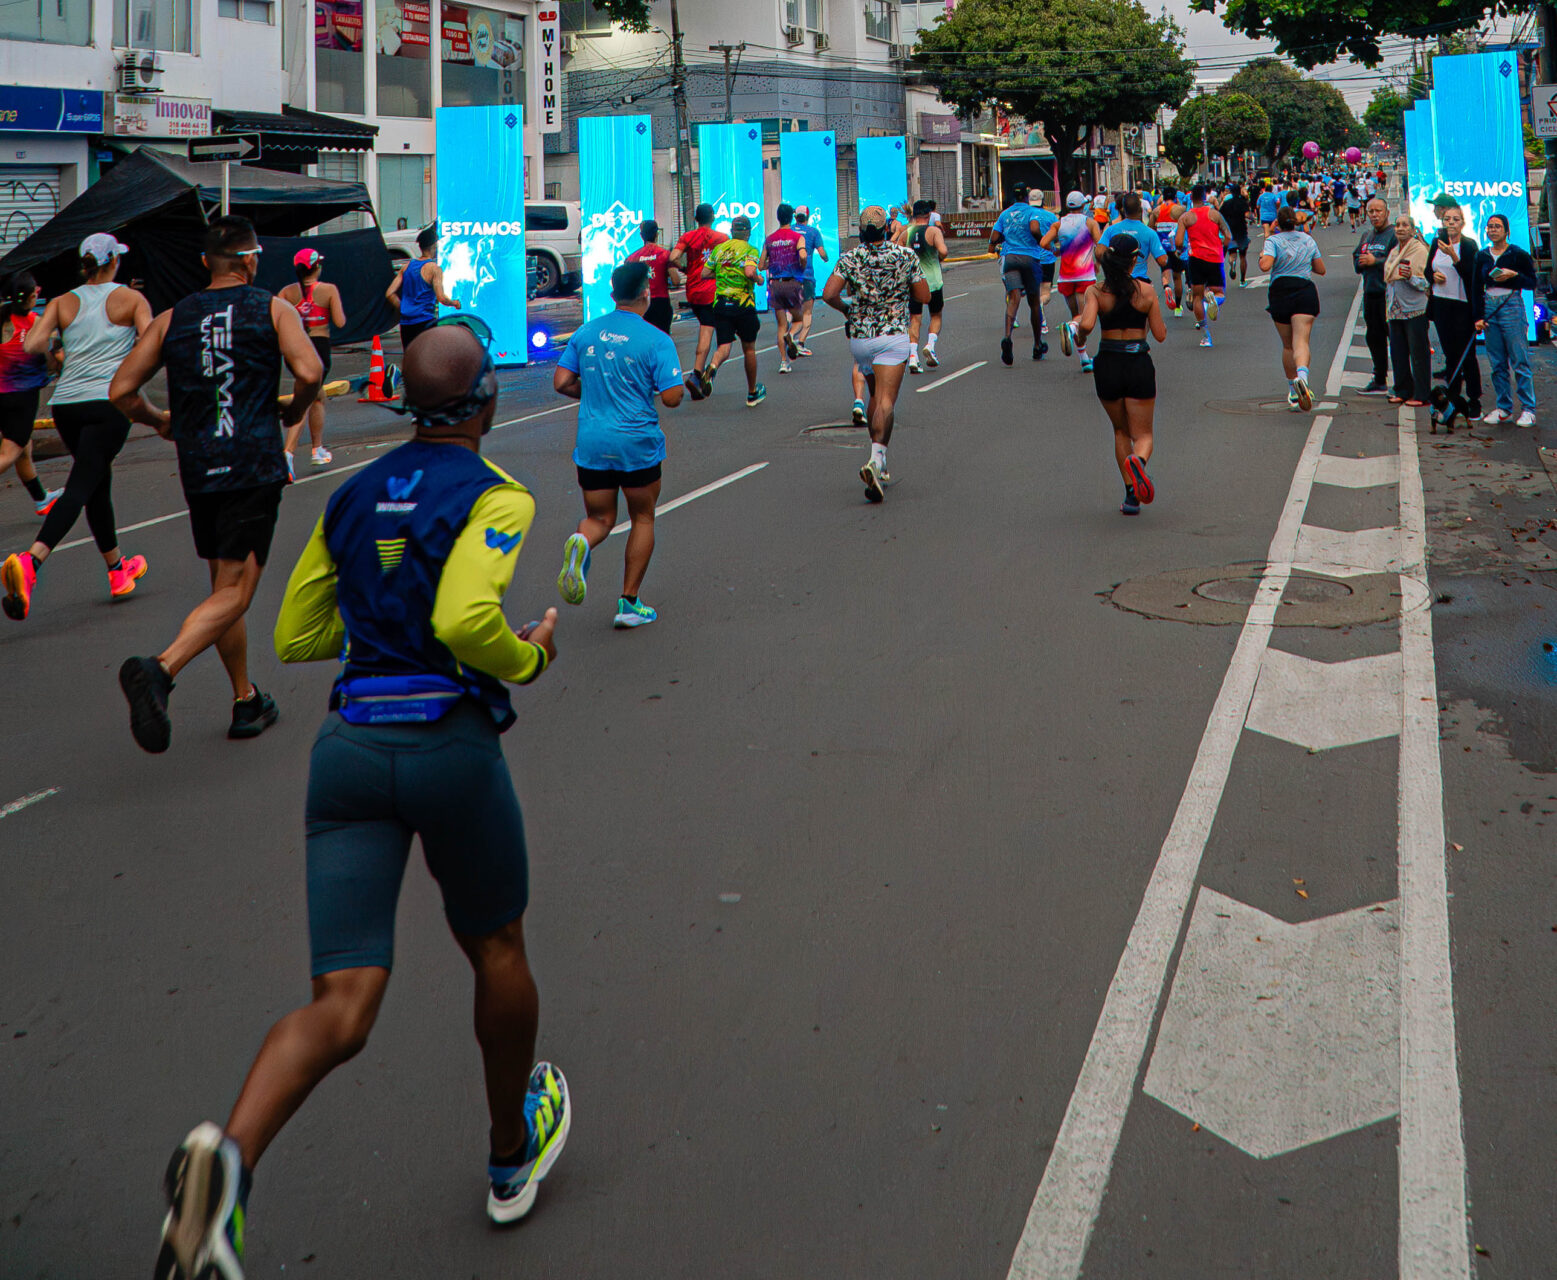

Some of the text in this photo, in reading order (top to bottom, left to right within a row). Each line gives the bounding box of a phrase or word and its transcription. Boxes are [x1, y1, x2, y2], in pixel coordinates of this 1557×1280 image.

[542, 28, 554, 57] MY
[544, 62, 555, 125] HOME
[155, 96, 211, 120] Innovar
[1444, 181, 1523, 197] ESTAMOS
[714, 202, 760, 219] ADO
[441, 221, 522, 236] ESTAMOS
[592, 213, 616, 229] DE
[200, 314, 214, 378] RUNNER
